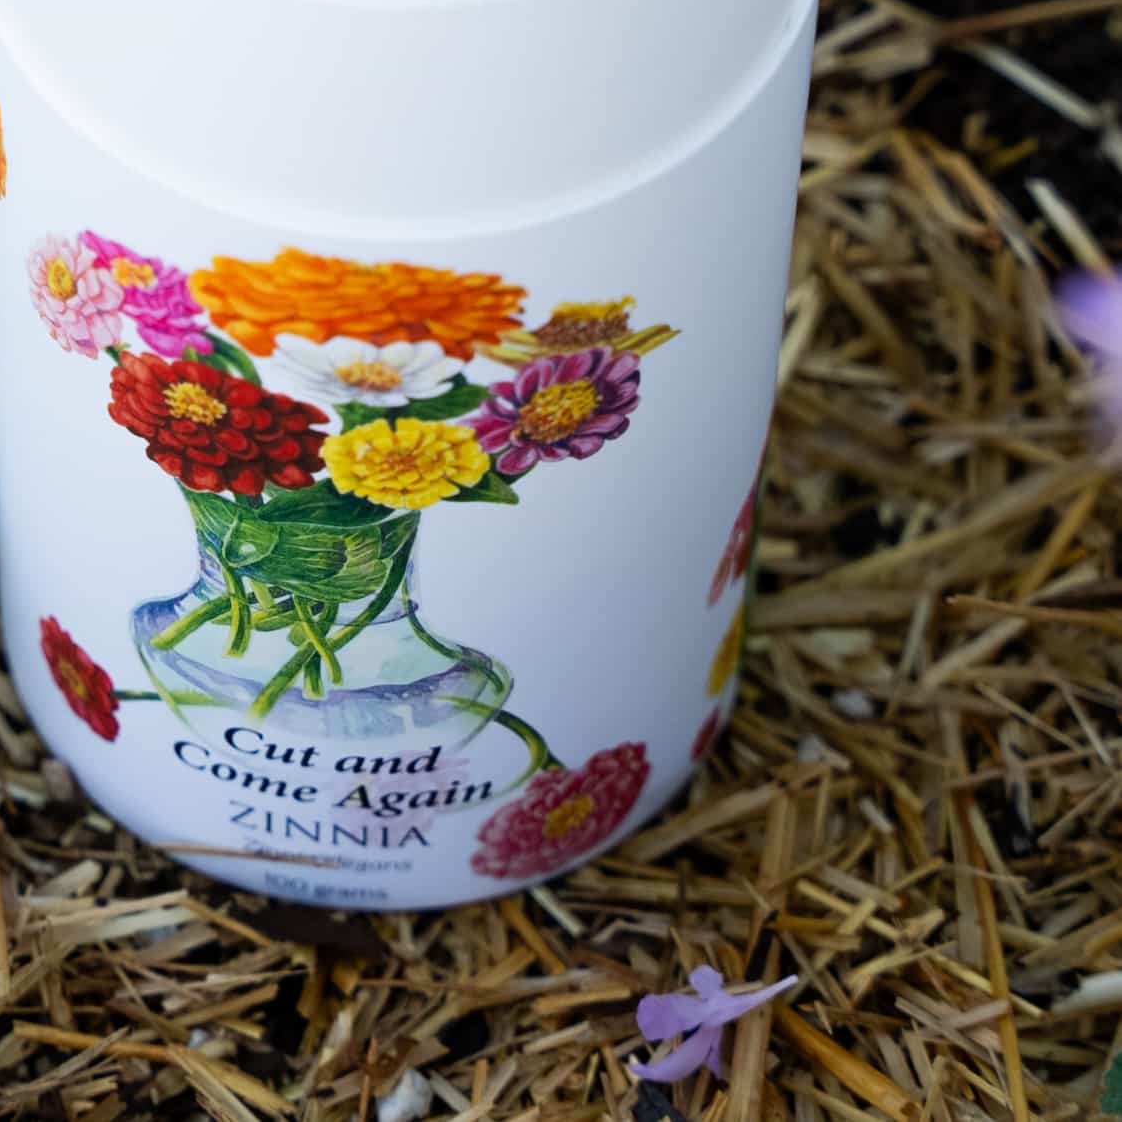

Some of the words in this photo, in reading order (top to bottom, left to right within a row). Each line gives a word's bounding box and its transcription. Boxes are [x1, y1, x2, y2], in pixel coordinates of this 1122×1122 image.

[224, 726, 320, 768] Cut
[334, 745, 442, 775] and
[173, 740, 318, 804] Come
[332, 780, 493, 818] Again
[228, 800, 431, 849] ZINNIA
